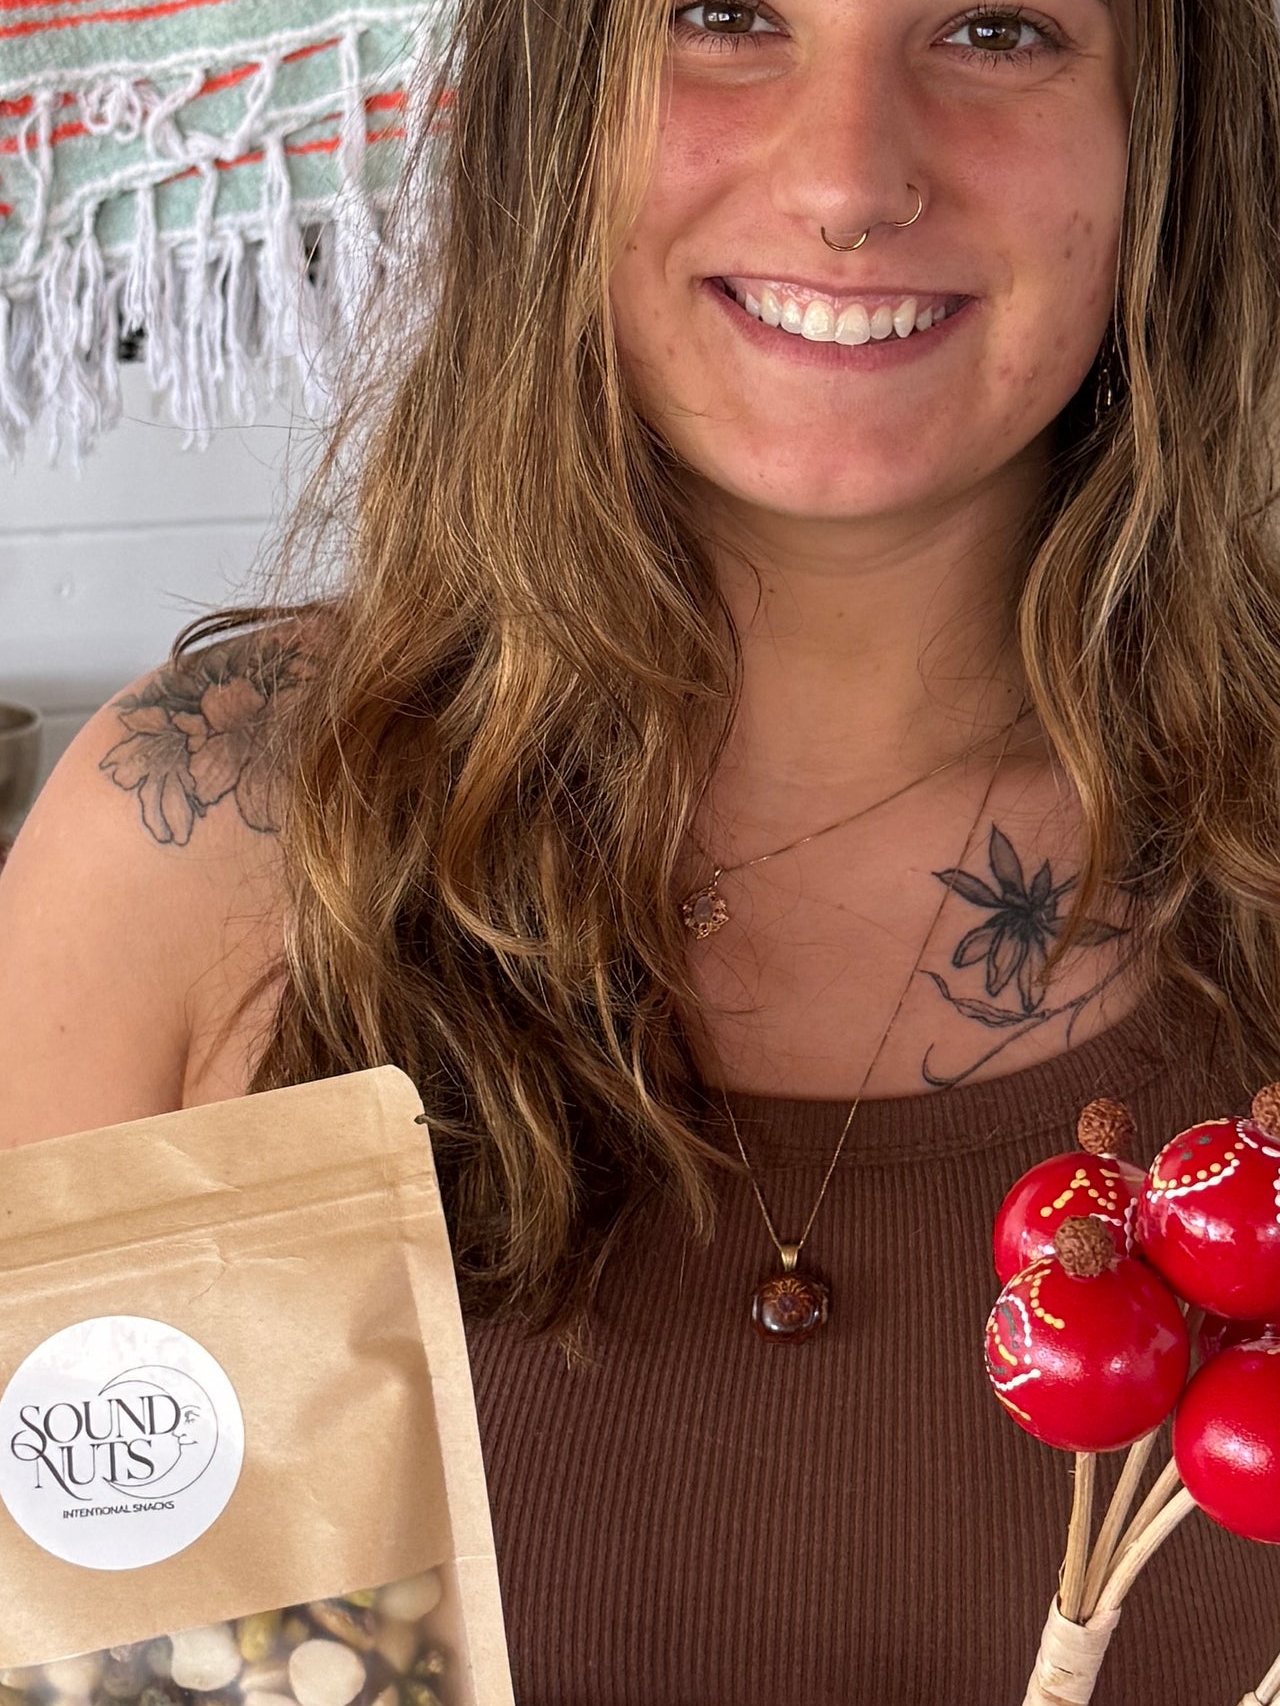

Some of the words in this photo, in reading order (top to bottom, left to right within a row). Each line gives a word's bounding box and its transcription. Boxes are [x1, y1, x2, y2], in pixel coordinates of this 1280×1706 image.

[11, 1394, 182, 1461] SOUND
[12, 1439, 156, 1501] NUTS
[63, 1504, 131, 1519] INTENTIONAL
[132, 1500, 175, 1513] SNACKS
